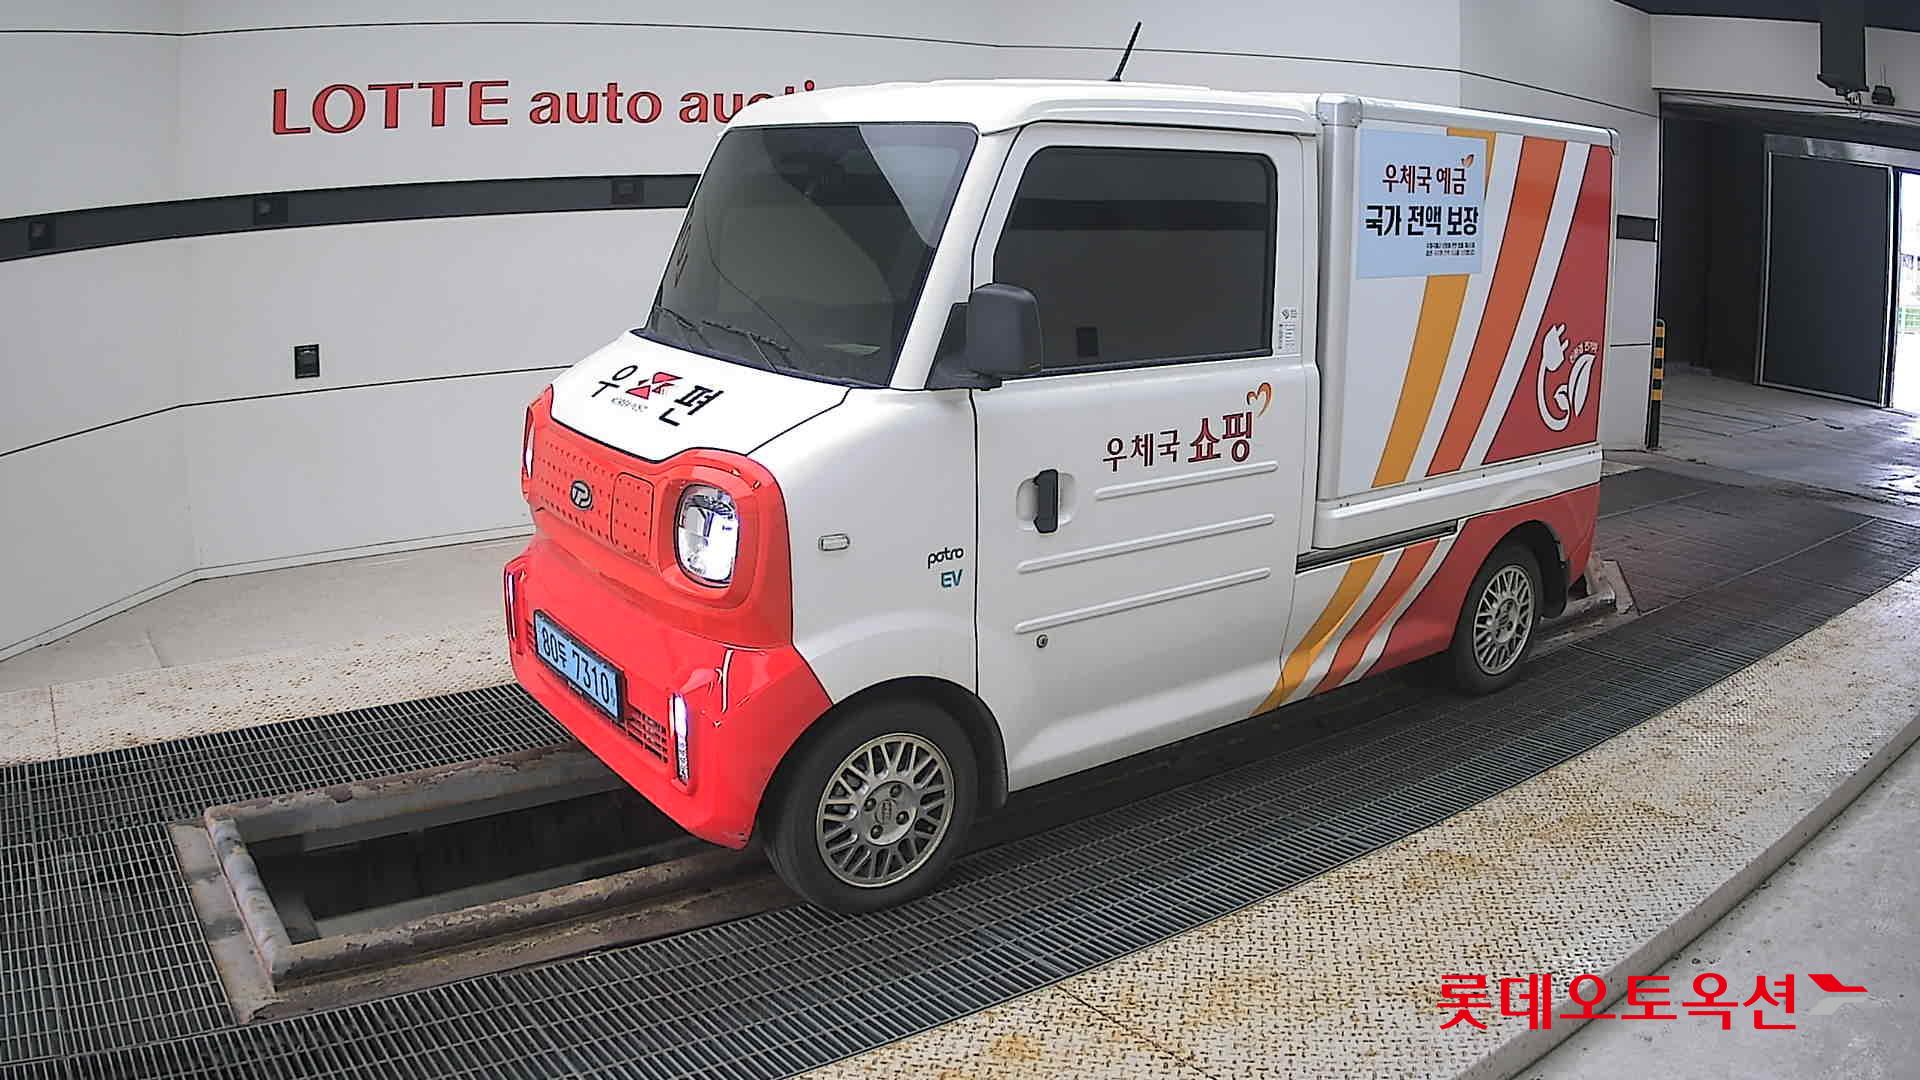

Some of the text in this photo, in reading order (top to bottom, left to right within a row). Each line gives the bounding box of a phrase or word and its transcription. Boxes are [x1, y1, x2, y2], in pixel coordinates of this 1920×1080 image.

[273, 80, 509, 135] LOTTE
[529, 82, 662, 124] auto
[1382, 164, 1467, 195] 우체국 예금
[1365, 204, 1479, 236] 국가 전액 보장
[1103, 411, 1253, 473] 우체국 쇼핑
[941, 569, 963, 588] EV
[541, 626, 610, 704] 80두 7310
